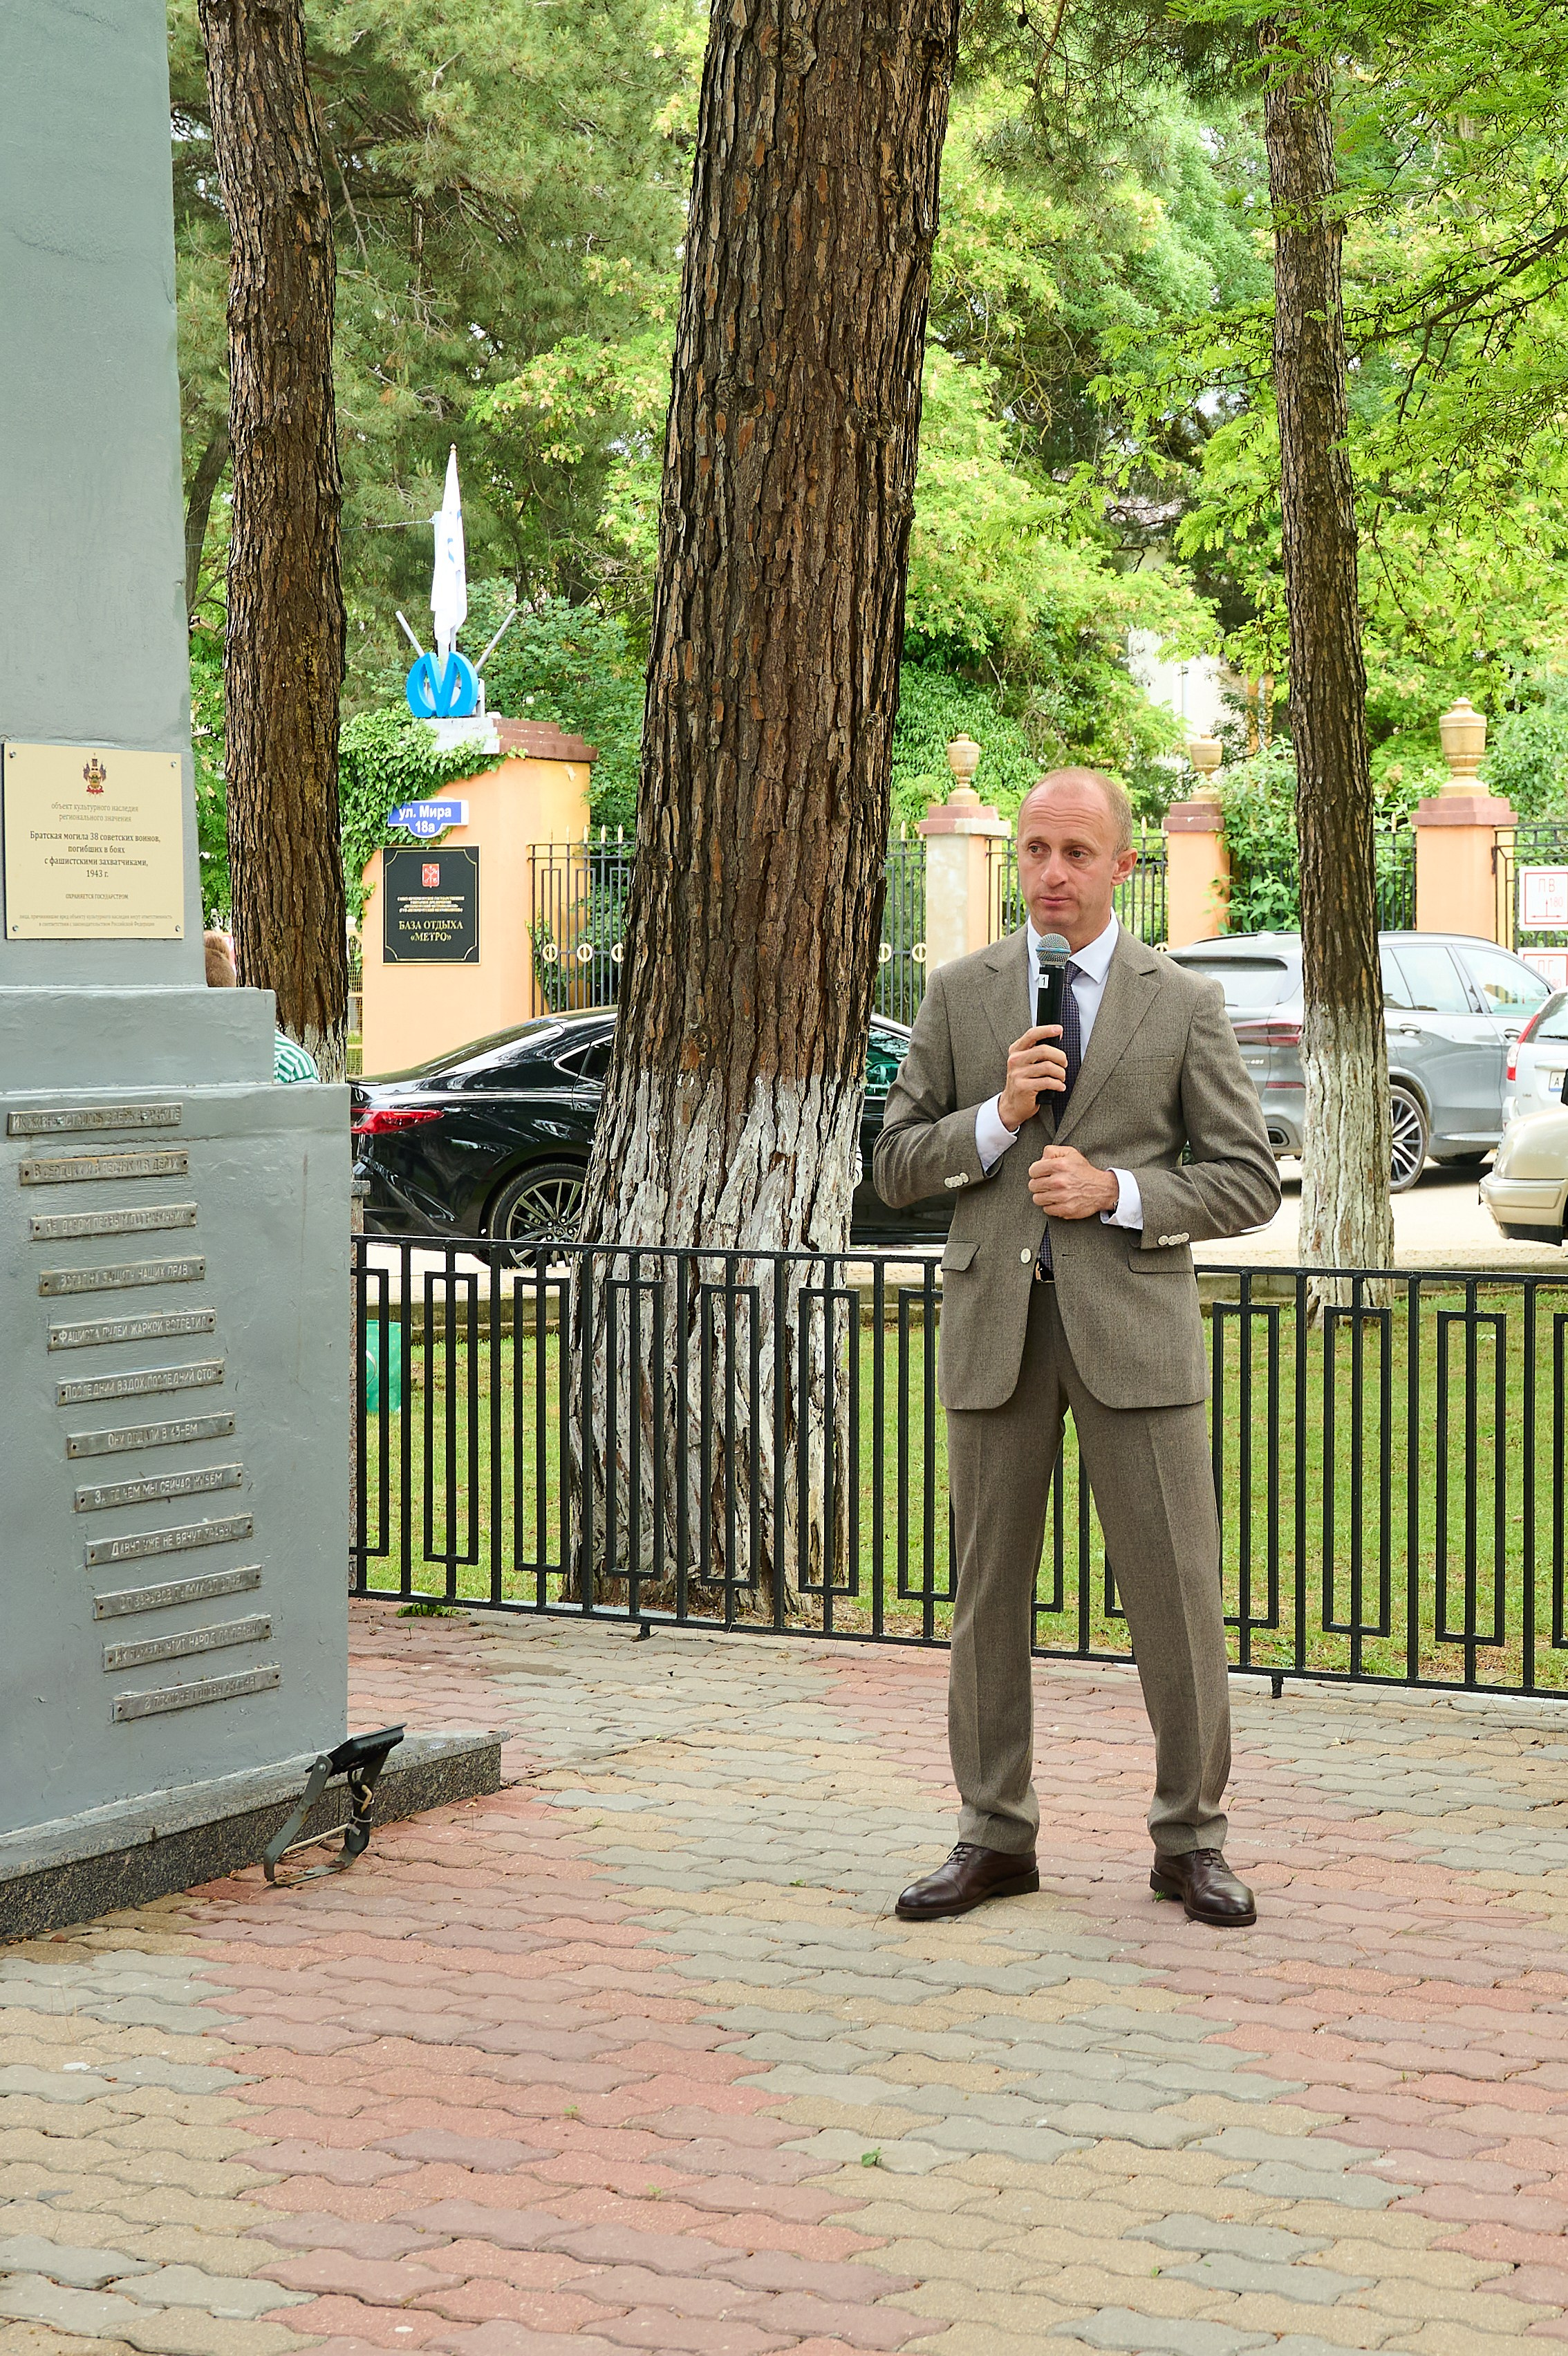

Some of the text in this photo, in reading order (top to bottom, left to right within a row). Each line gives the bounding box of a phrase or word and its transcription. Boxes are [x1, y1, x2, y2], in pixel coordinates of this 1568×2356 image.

[74, 803, 111, 812] культурного
[399, 805, 451, 821] ул. Мира
[416, 820, 435, 833] 18а
[30, 831, 62, 841] Братская
[90, 832, 98, 841] 38
[68, 845, 102, 853] погибших
[109, 845, 125, 853] боях
[50, 857, 97, 866] фашистскими
[1549, 897, 1563, 907] 180
[398, 920, 463, 931] БАЗА ОТДЫХА
[410, 932, 451, 942] «МЕТРО»
[1042, 977, 1045, 986] 1
[168, 1264, 187, 1276] ПРАВ
[59, 1329, 100, 1343] ФАШИСТА
[197, 1368, 217, 1381] СТОН
[162, 1428, 167, 1439] В
[143, 1482, 157, 1495] МЫ
[163, 1534, 173, 1547] НЕ
[189, 1632, 216, 1647] НАРОД
